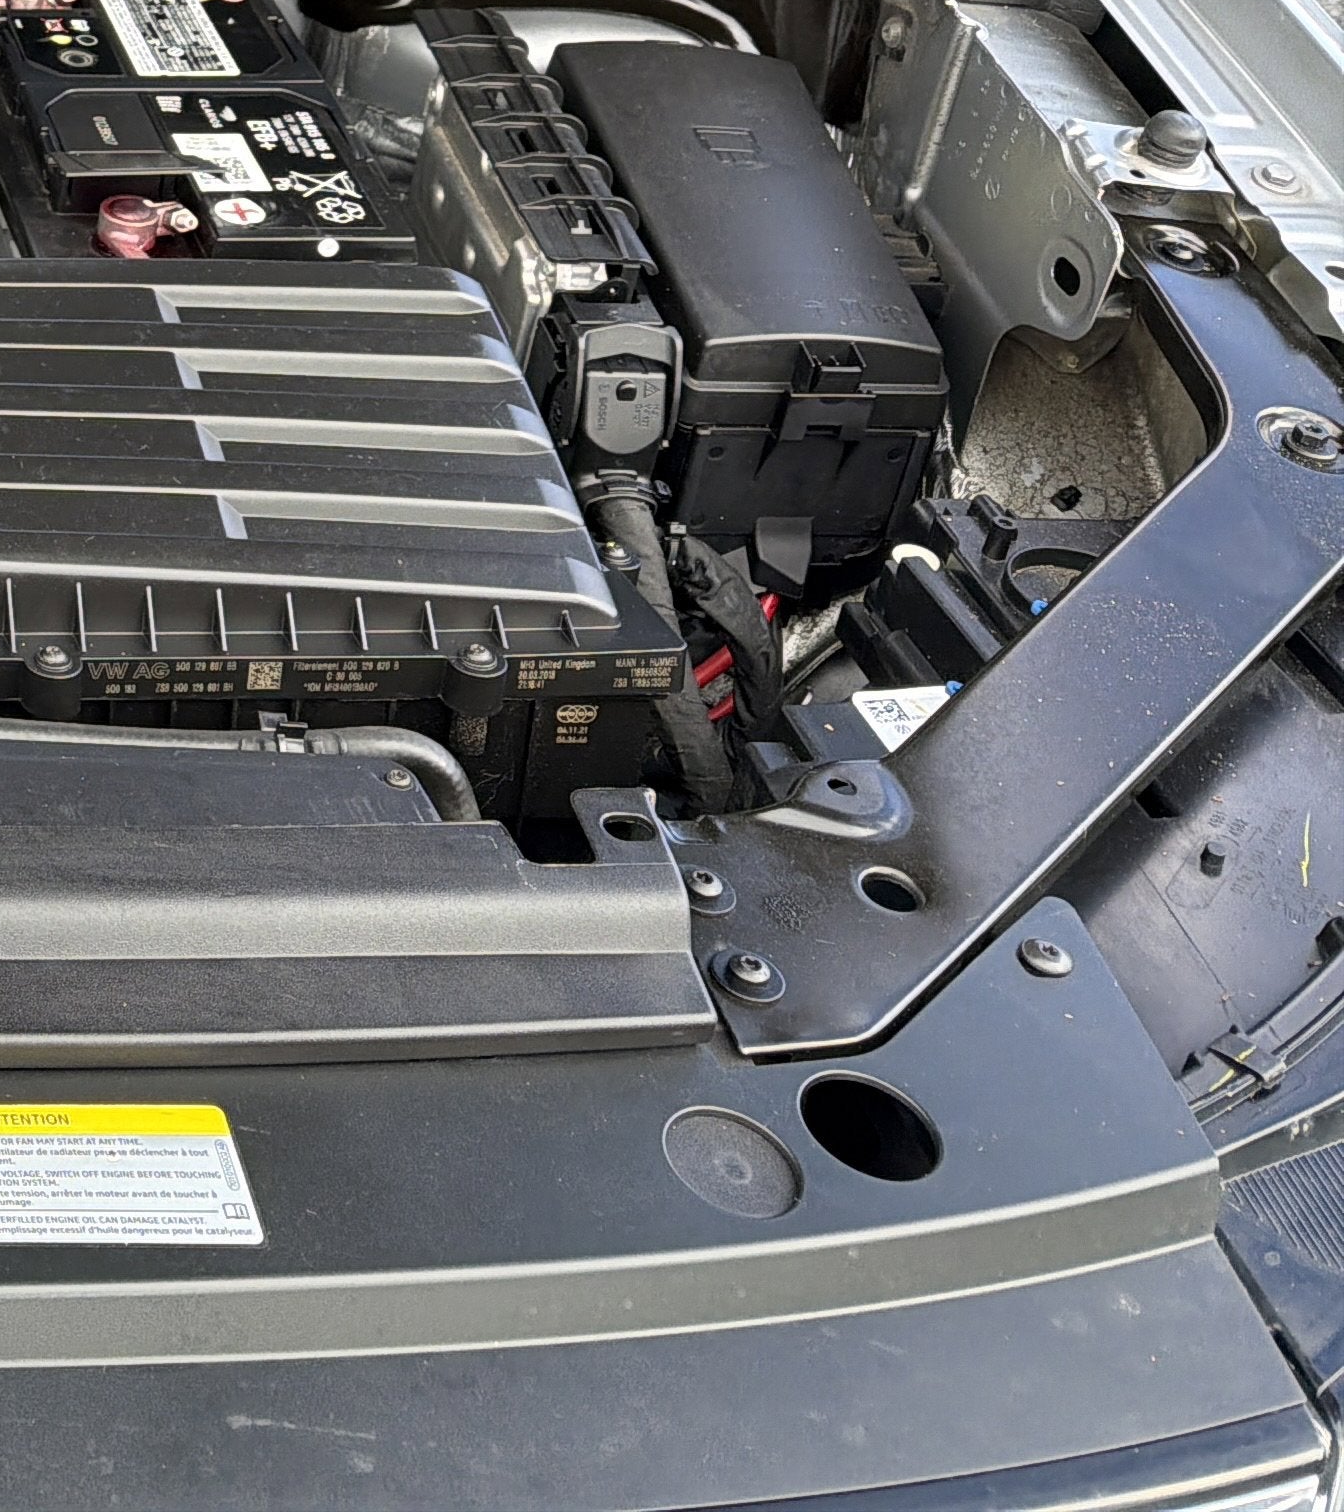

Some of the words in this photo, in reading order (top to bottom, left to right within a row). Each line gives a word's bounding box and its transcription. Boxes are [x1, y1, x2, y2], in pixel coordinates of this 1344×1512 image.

[246, 120, 278, 151] EFB+
[598, 397, 608, 430] BOSCH
[539, 660, 562, 669] United
[565, 660, 596, 670] Kingdom
[616, 658, 636, 668] MANN
[87, 662, 130, 679] VW
[132, 662, 171, 679] AG
[16, 1138, 34, 1146] FAN
[36, 1138, 54, 1146] MAY
[57, 1138, 84, 1146] START
[86, 1138, 96, 1146] AT
[98, 1138, 116, 1146] ANY
[36, 1148, 48, 1156] de
[50, 1148, 92, 1156] radiateur
[129, 1148, 178, 1156] déclencher
[181, 1148, 188, 1156] à
[176, 1171, 222, 1179] TOUCHING
[51, 1190, 82, 1198] arrêter
[84, 1190, 94, 1198] le
[96, 1190, 129, 1198] moteur
[160, 1190, 172, 1198] de
[174, 1190, 209, 1198] toucher
[211, 1190, 218, 1198] à
[46, 1216, 80, 1224] ENGINE
[82, 1216, 96, 1224] OIL
[98, 1216, 118, 1224] CAN
[50, 1226, 86, 1234] excessif
[88, 1226, 119, 1234] d'huile
[122, 1227, 170, 1236] dangereux
[172, 1228, 192, 1236] pour
[194, 1227, 204, 1235] le
